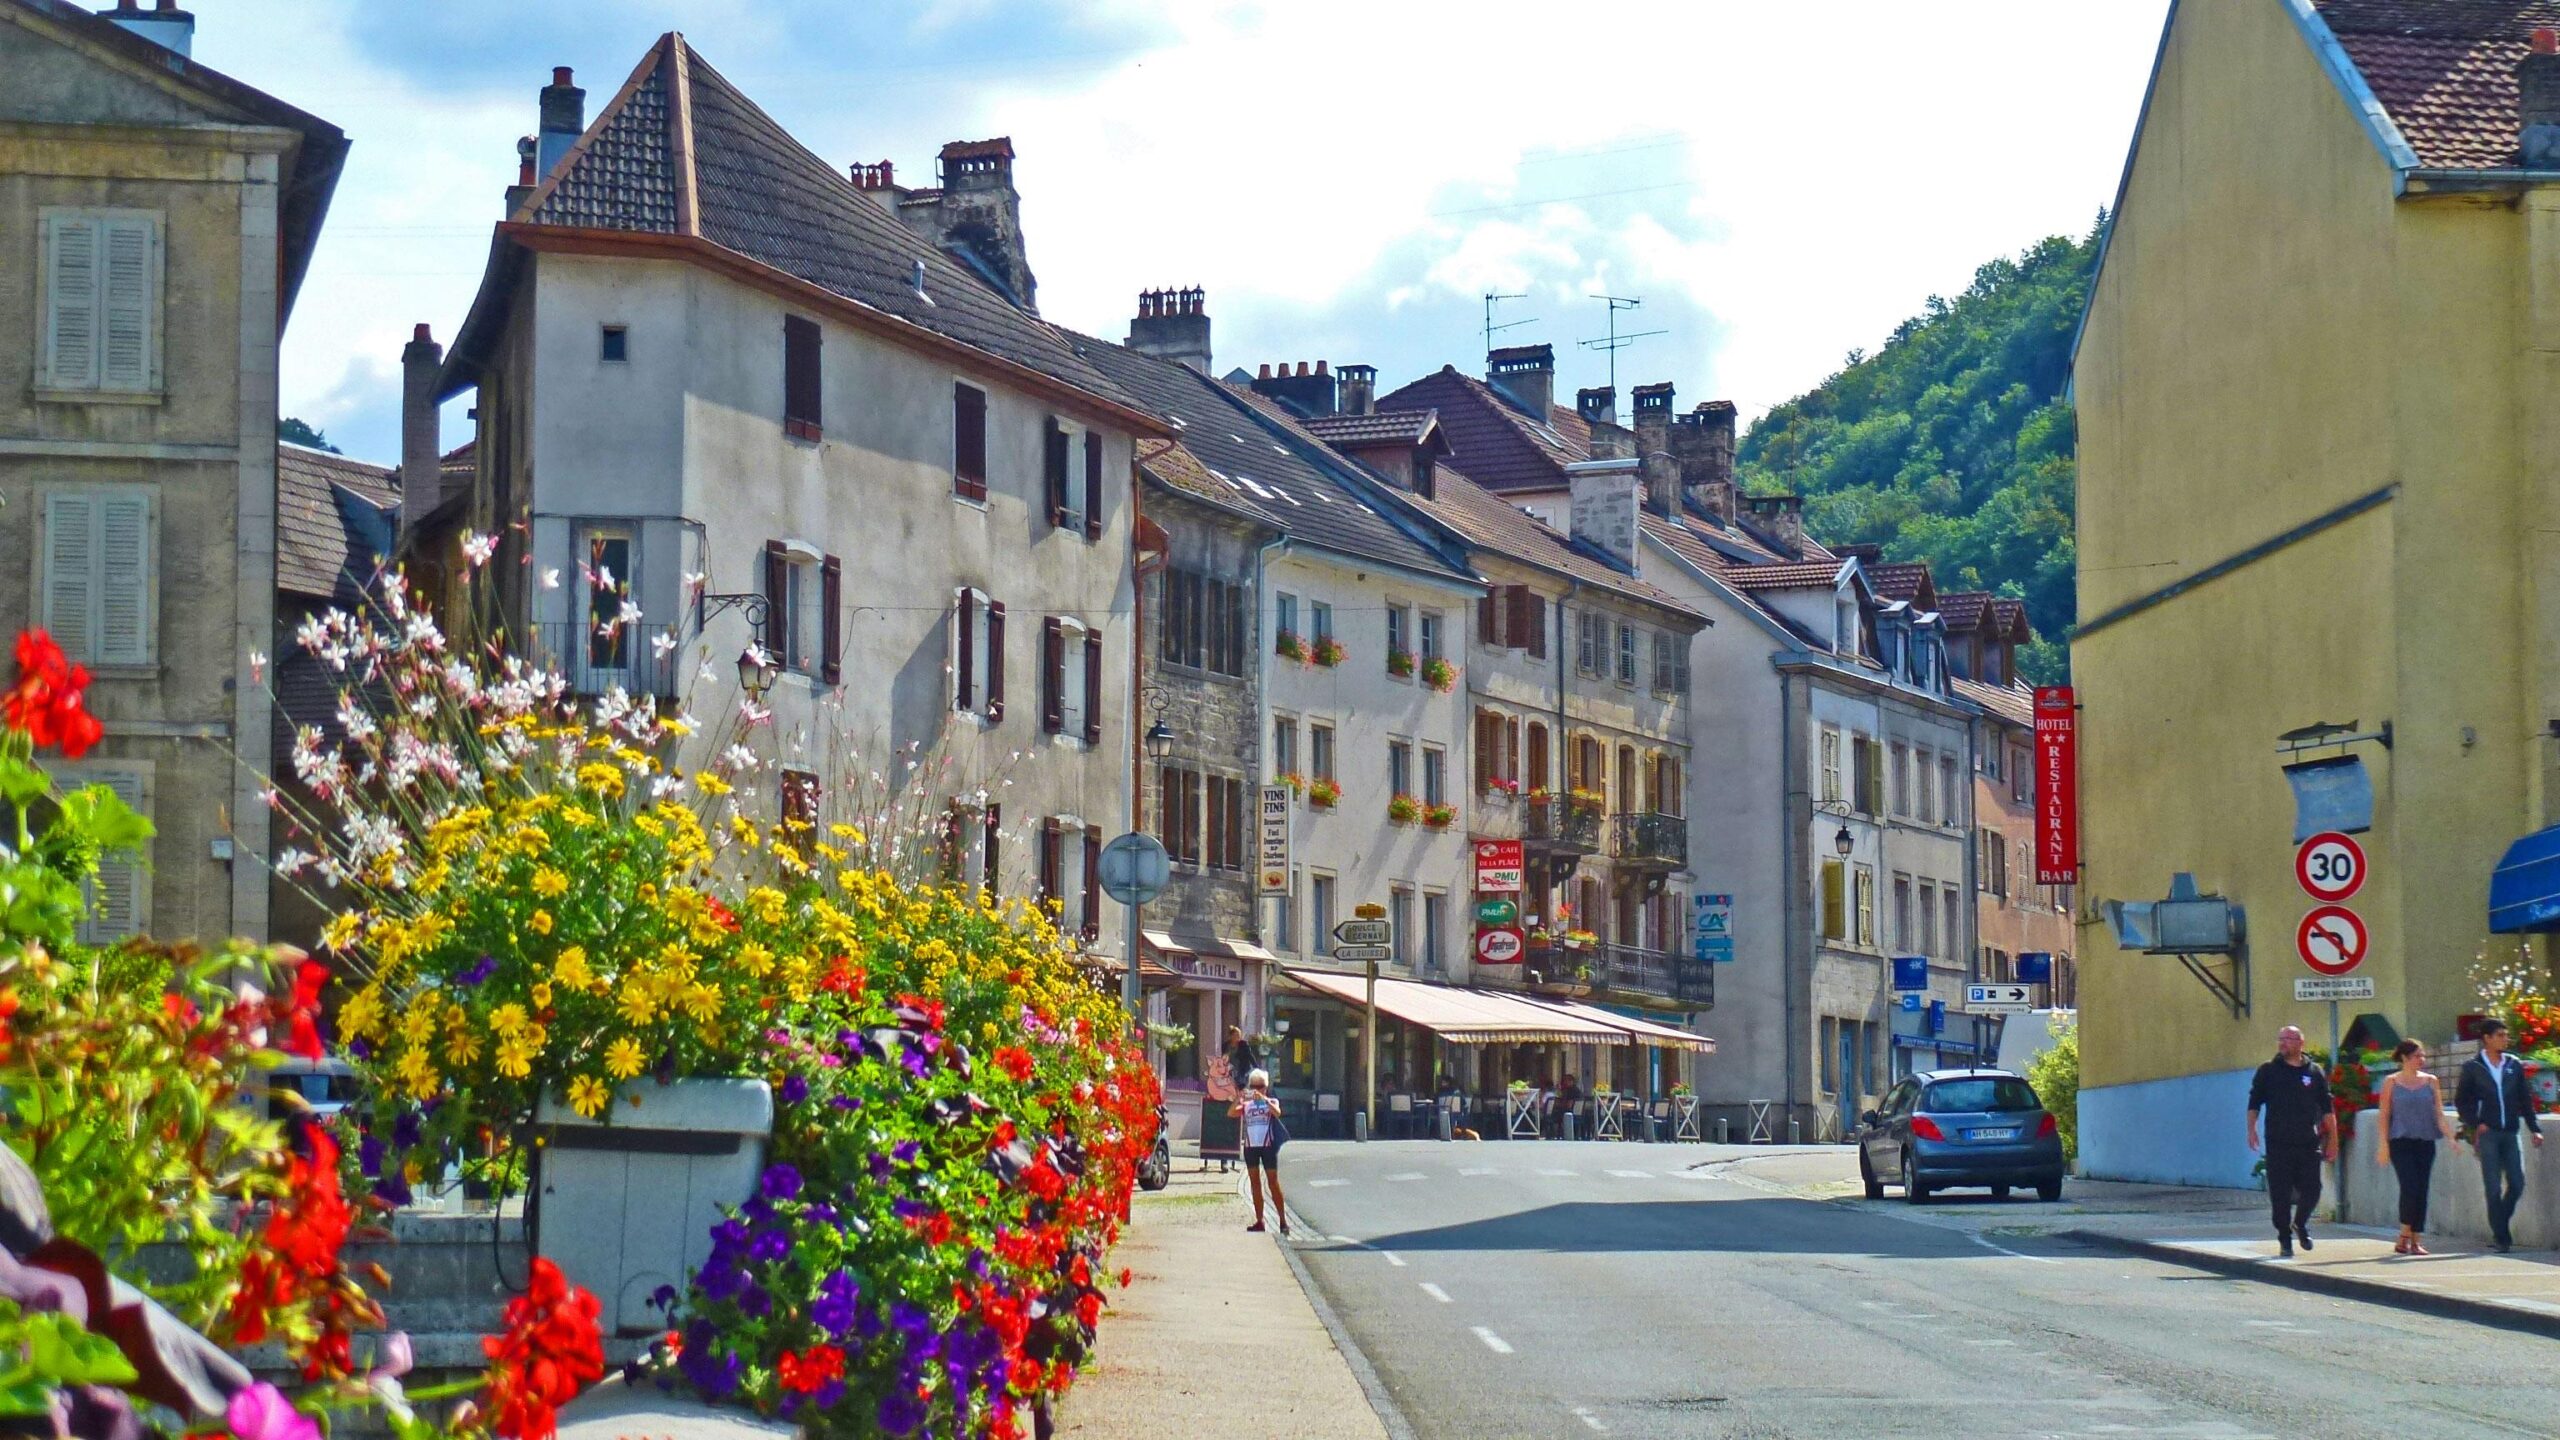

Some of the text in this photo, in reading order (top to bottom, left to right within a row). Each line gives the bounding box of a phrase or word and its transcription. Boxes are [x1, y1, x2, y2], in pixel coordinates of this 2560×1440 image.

[2036, 719, 2072, 731] HOTEL
[1263, 790, 1285, 801] VINS
[1263, 802, 1285, 813] FINS
[2048, 745, 2063, 865] RESTAURANT
[1498, 859, 1519, 867] PLACE
[2312, 853, 2351, 881] 30
[1494, 871, 1519, 881] PMU
[2040, 870, 2073, 882] BAR
[2356, 979, 2367, 988] ET
